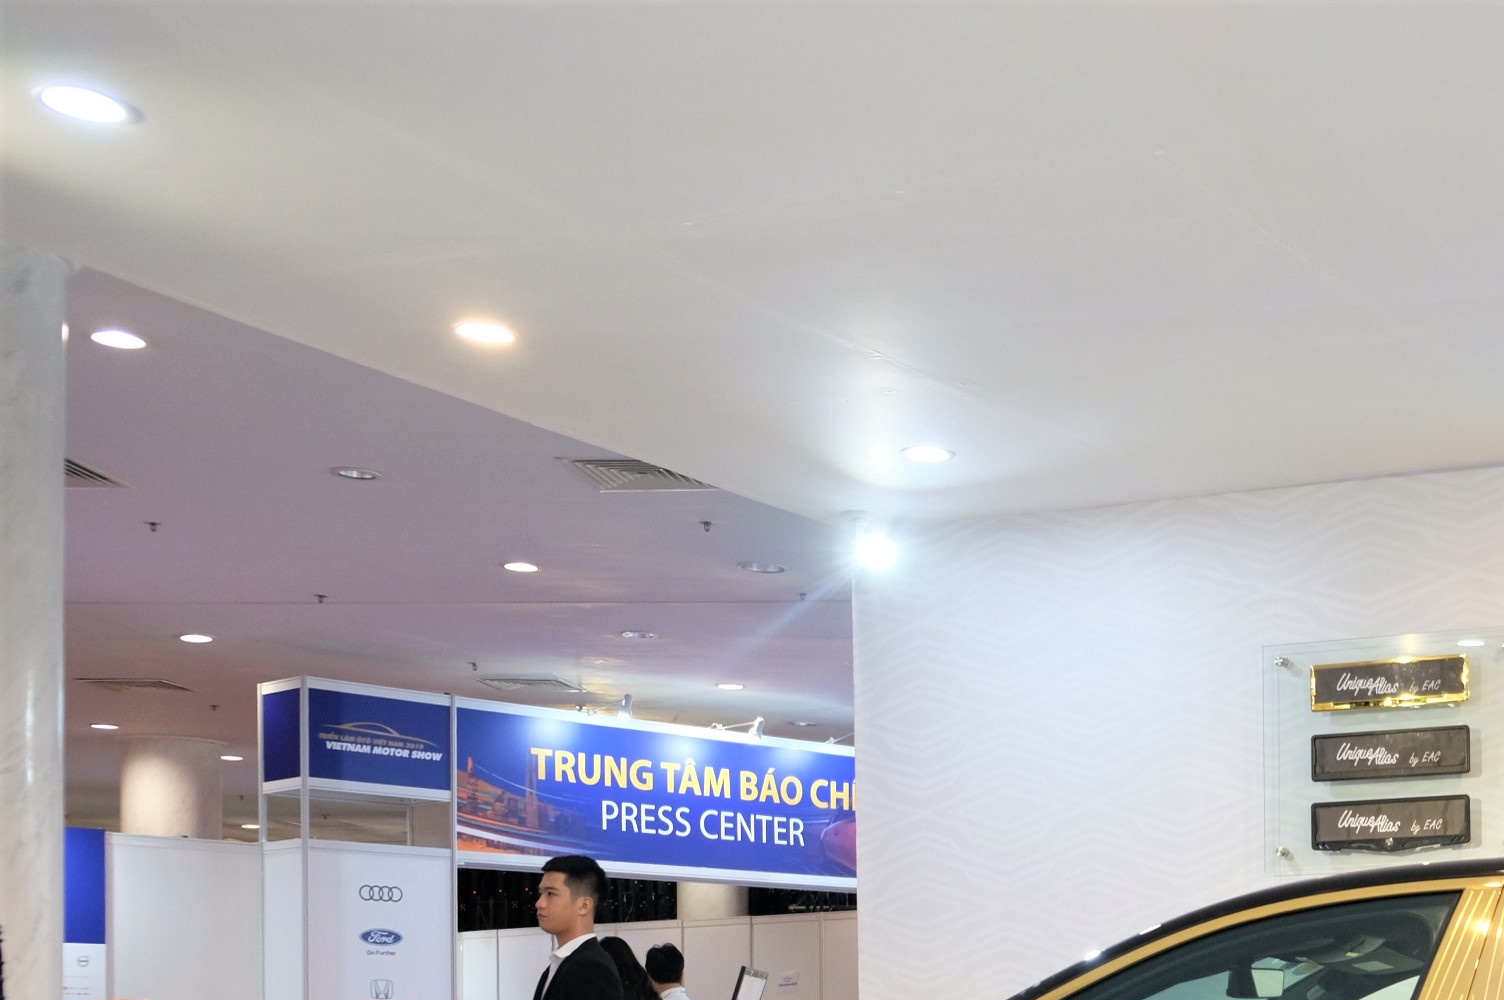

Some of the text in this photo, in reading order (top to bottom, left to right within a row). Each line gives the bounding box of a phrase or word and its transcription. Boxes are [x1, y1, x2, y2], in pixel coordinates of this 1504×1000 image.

[1409, 681, 1420, 696] by
[1422, 679, 1442, 692] EAC
[325, 740, 443, 761] VIETNAM MOTOR SHOW
[1408, 752, 1420, 768] by
[1421, 750, 1442, 763] EAC
[530, 747, 654, 791] TRUNG
[660, 757, 732, 799] TÂM
[739, 767, 803, 806] BÁO
[601, 800, 806, 847] PRESS CENTER
[1410, 820, 1421, 836] by
[1423, 818, 1443, 831] EAC
[367, 930, 396, 944] Ford
